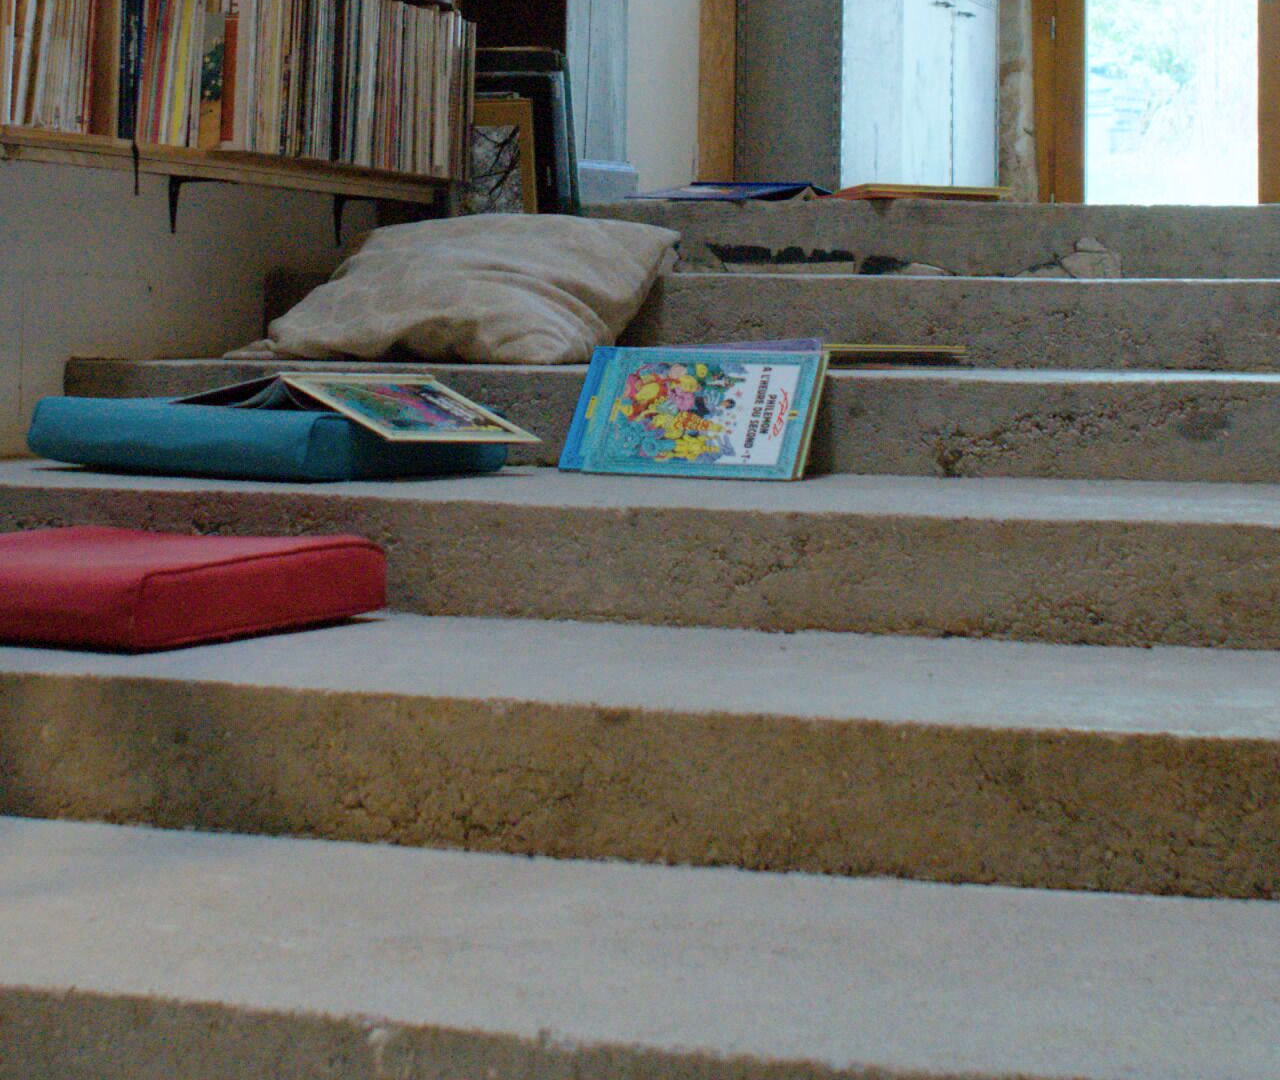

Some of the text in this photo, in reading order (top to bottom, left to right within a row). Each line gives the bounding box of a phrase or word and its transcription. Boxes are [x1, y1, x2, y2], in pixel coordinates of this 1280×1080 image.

[755, 374, 770, 404] L'HEURE
[752, 407, 763, 417] DU
[760, 394, 777, 434] PHILEMON
[744, 420, 759, 448] SECOND
